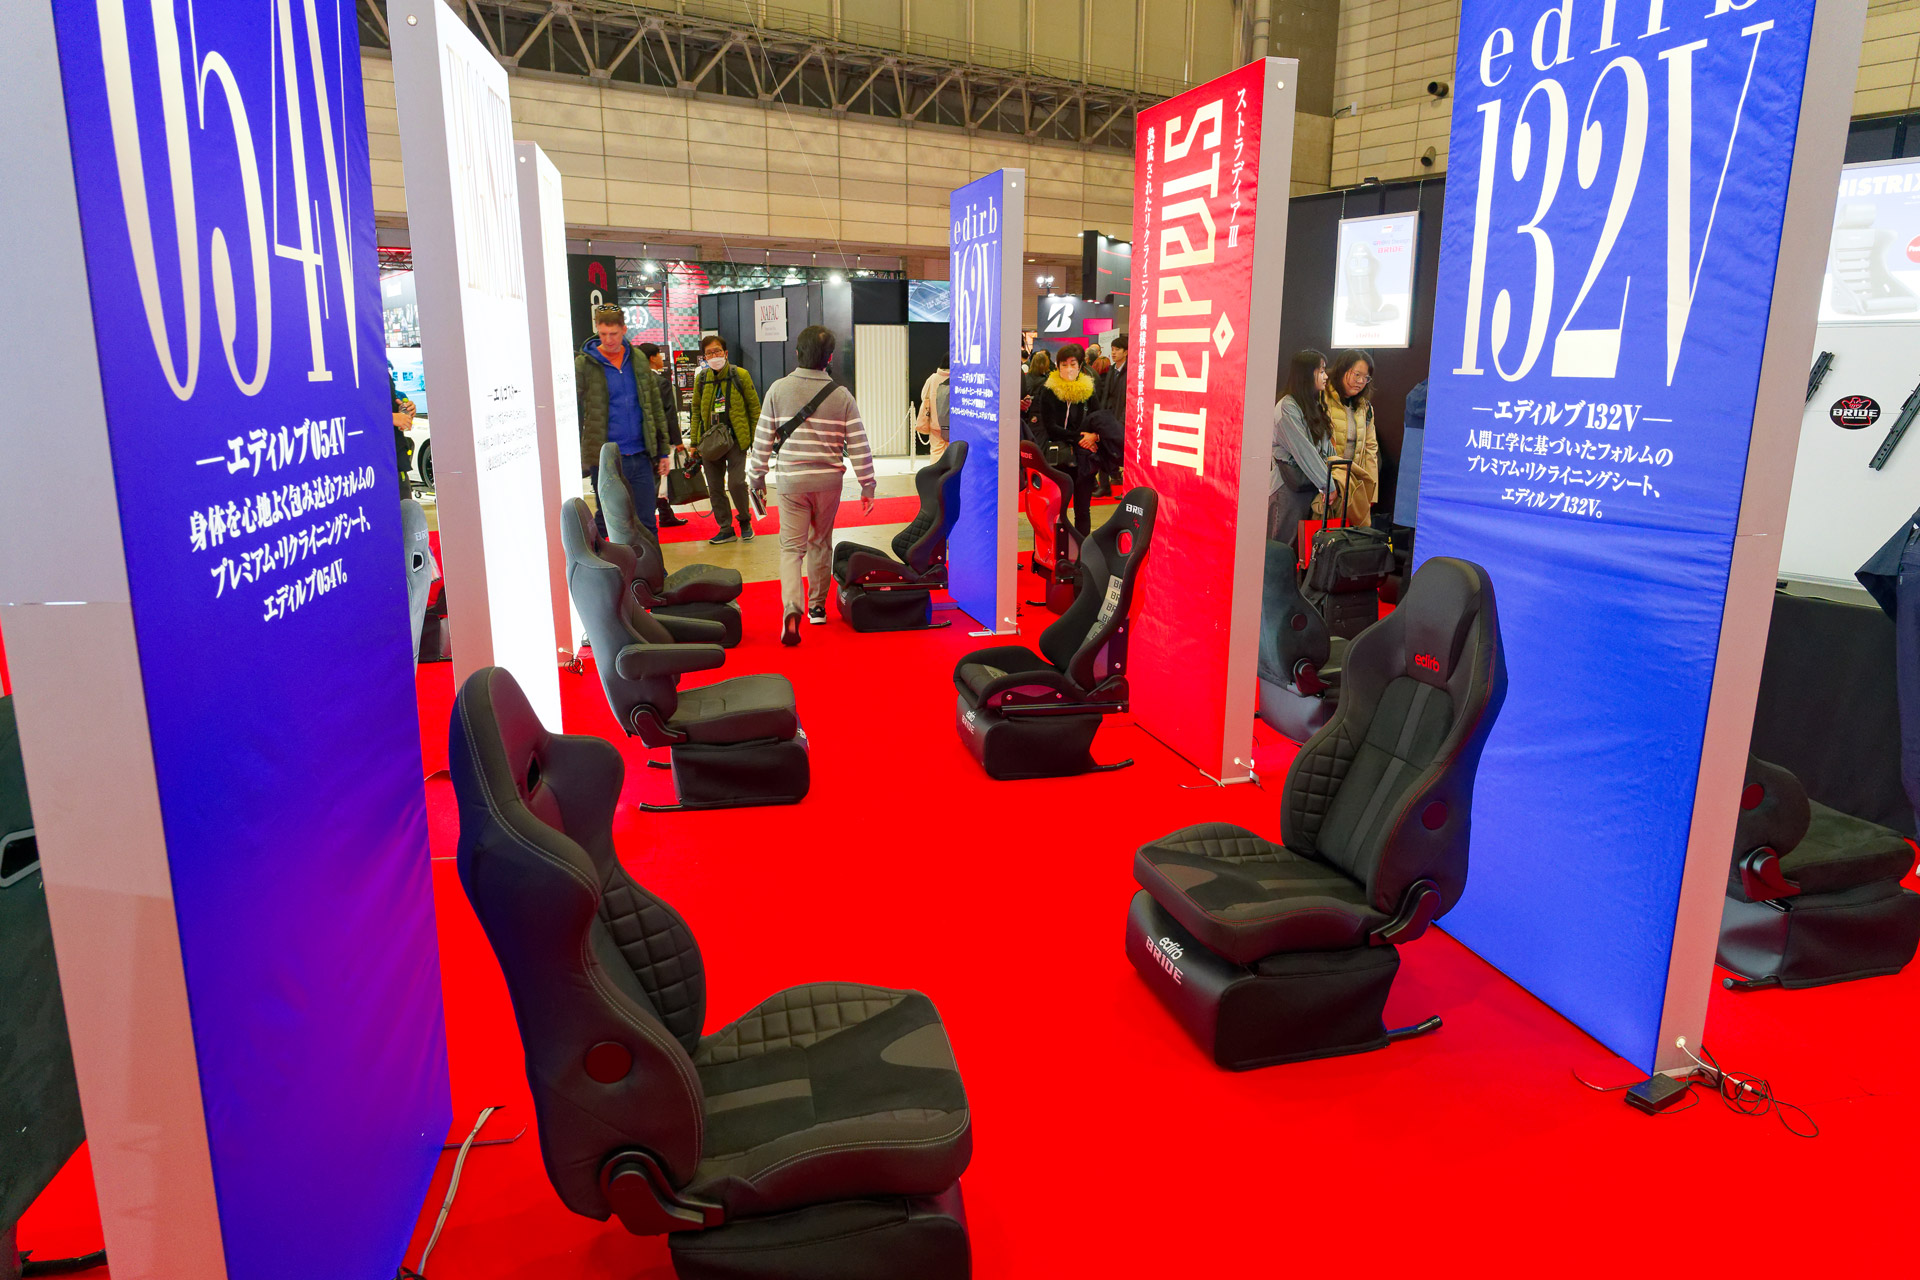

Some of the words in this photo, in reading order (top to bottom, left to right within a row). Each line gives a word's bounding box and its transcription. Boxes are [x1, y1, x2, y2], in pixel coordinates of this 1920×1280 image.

[1479, 0, 1752, 88] edi
[953, 196, 998, 245] edirb
[1452, 20, 1775, 387] 132V
[953, 240, 998, 367] 162V
[1832, 408, 1879, 418] BRIDE
[1465, 429, 1674, 467] 人間工学に基づいたフォルムの
[189, 465, 375, 553] 身体を心地よく包み込むフォルムの
[1145, 935, 1184, 985] BRIDE
[1158, 937, 1185, 960] edirb
